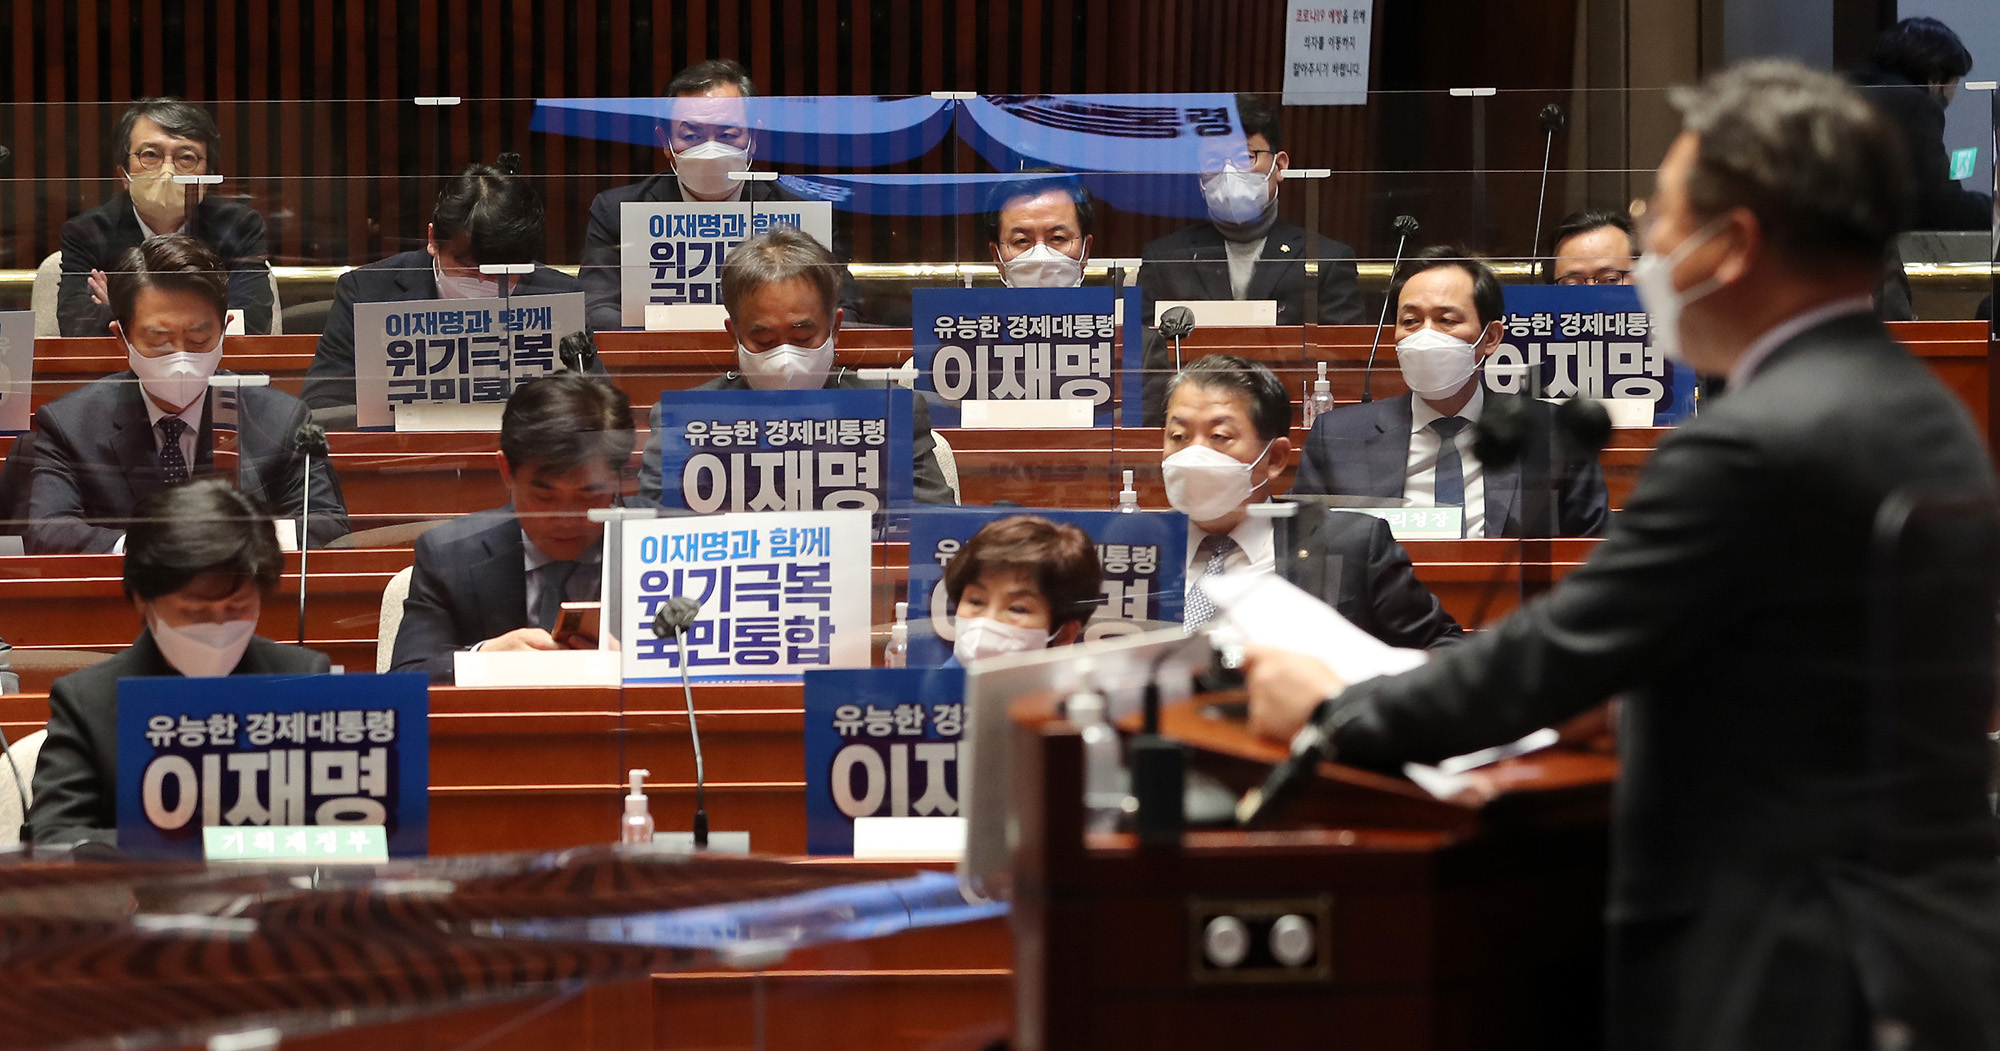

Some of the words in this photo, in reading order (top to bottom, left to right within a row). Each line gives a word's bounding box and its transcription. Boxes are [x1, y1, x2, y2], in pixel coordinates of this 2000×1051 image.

[650, 214, 746, 238] 이재명과
[385, 310, 493, 337] 이재명과
[499, 306, 552, 332] 함께
[934, 315, 1001, 339] 유능한
[1007, 313, 1114, 339] 경제대통령
[1560, 312, 1657, 337] 경제대통
[386, 333, 554, 377] 위기극복
[932, 342, 1111, 406] 이재명
[1484, 341, 1665, 402] 이재명
[685, 421, 759, 447] 유능한
[765, 419, 886, 447] 경제대통령
[683, 450, 880, 514] 이재명
[1381, 511, 1450, 529] 리청장
[640, 529, 760, 564] 이재명과
[769, 526, 831, 558] 함께
[637, 562, 832, 617] 위기극복
[636, 615, 836, 669] 국민통합
[145, 713, 239, 747] 유능한
[246, 709, 396, 744] 경제대통령
[832, 704, 925, 737] 유능한
[143, 747, 388, 830] 이재명
[222, 830, 371, 854] 기획재정부
